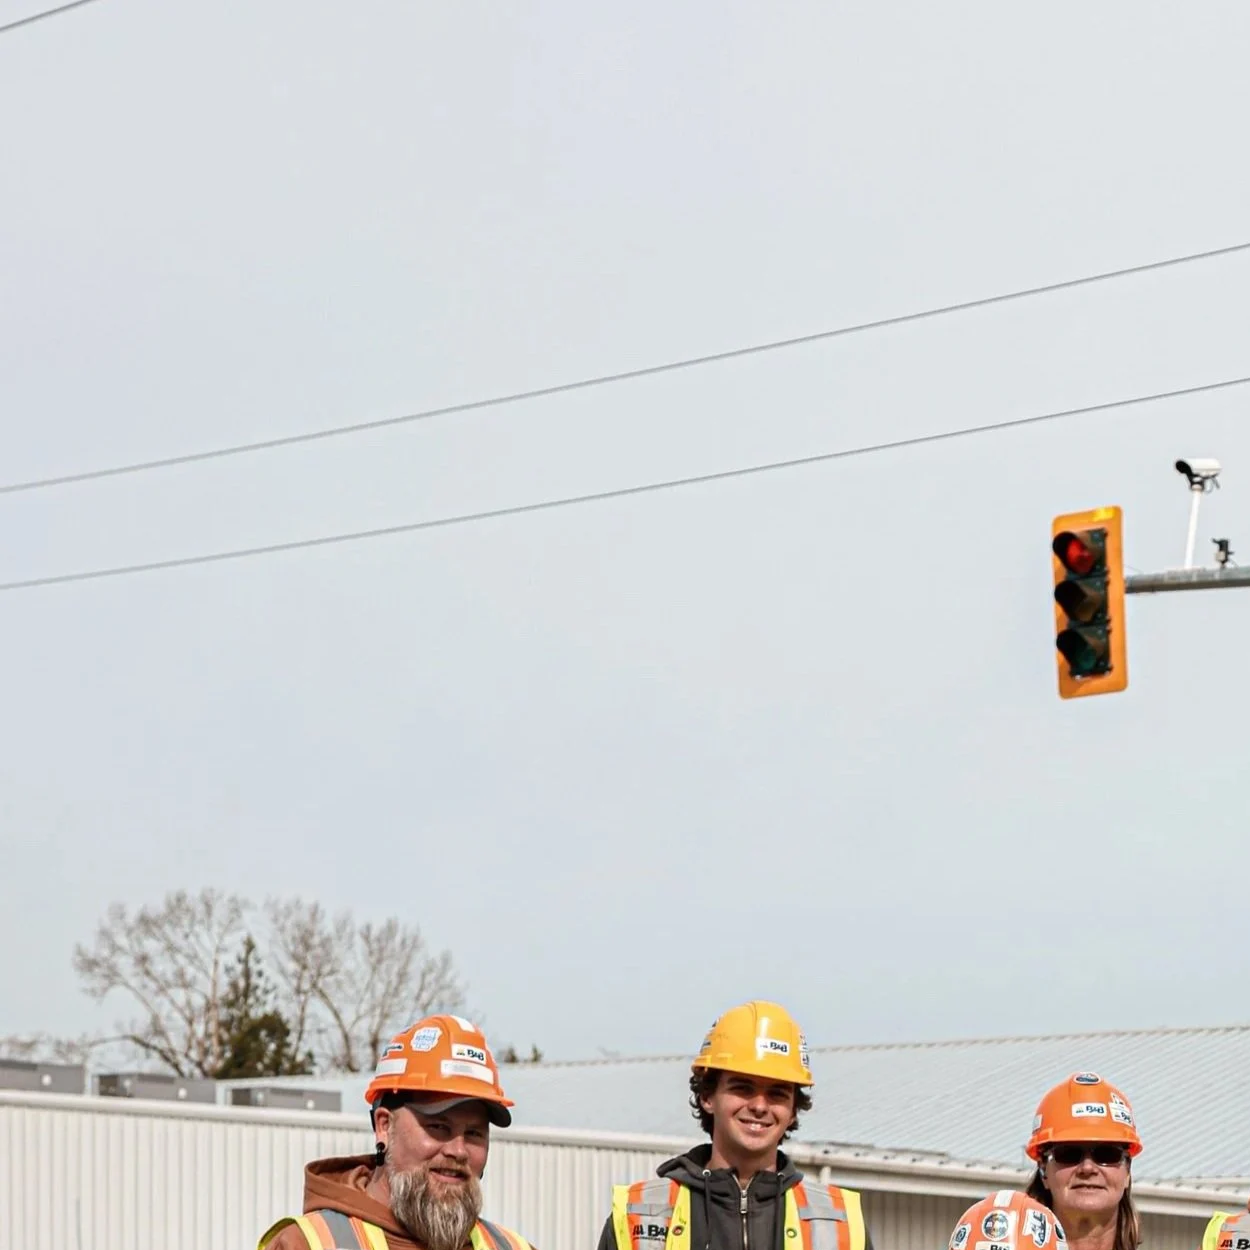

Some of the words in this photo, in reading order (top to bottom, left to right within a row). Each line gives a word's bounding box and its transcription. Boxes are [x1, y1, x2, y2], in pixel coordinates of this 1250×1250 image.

[769, 1041, 788, 1052] B&B
[467, 1049, 485, 1061] B&B
[1086, 1105, 1105, 1114] B&B
[648, 1225, 669, 1238] B&
